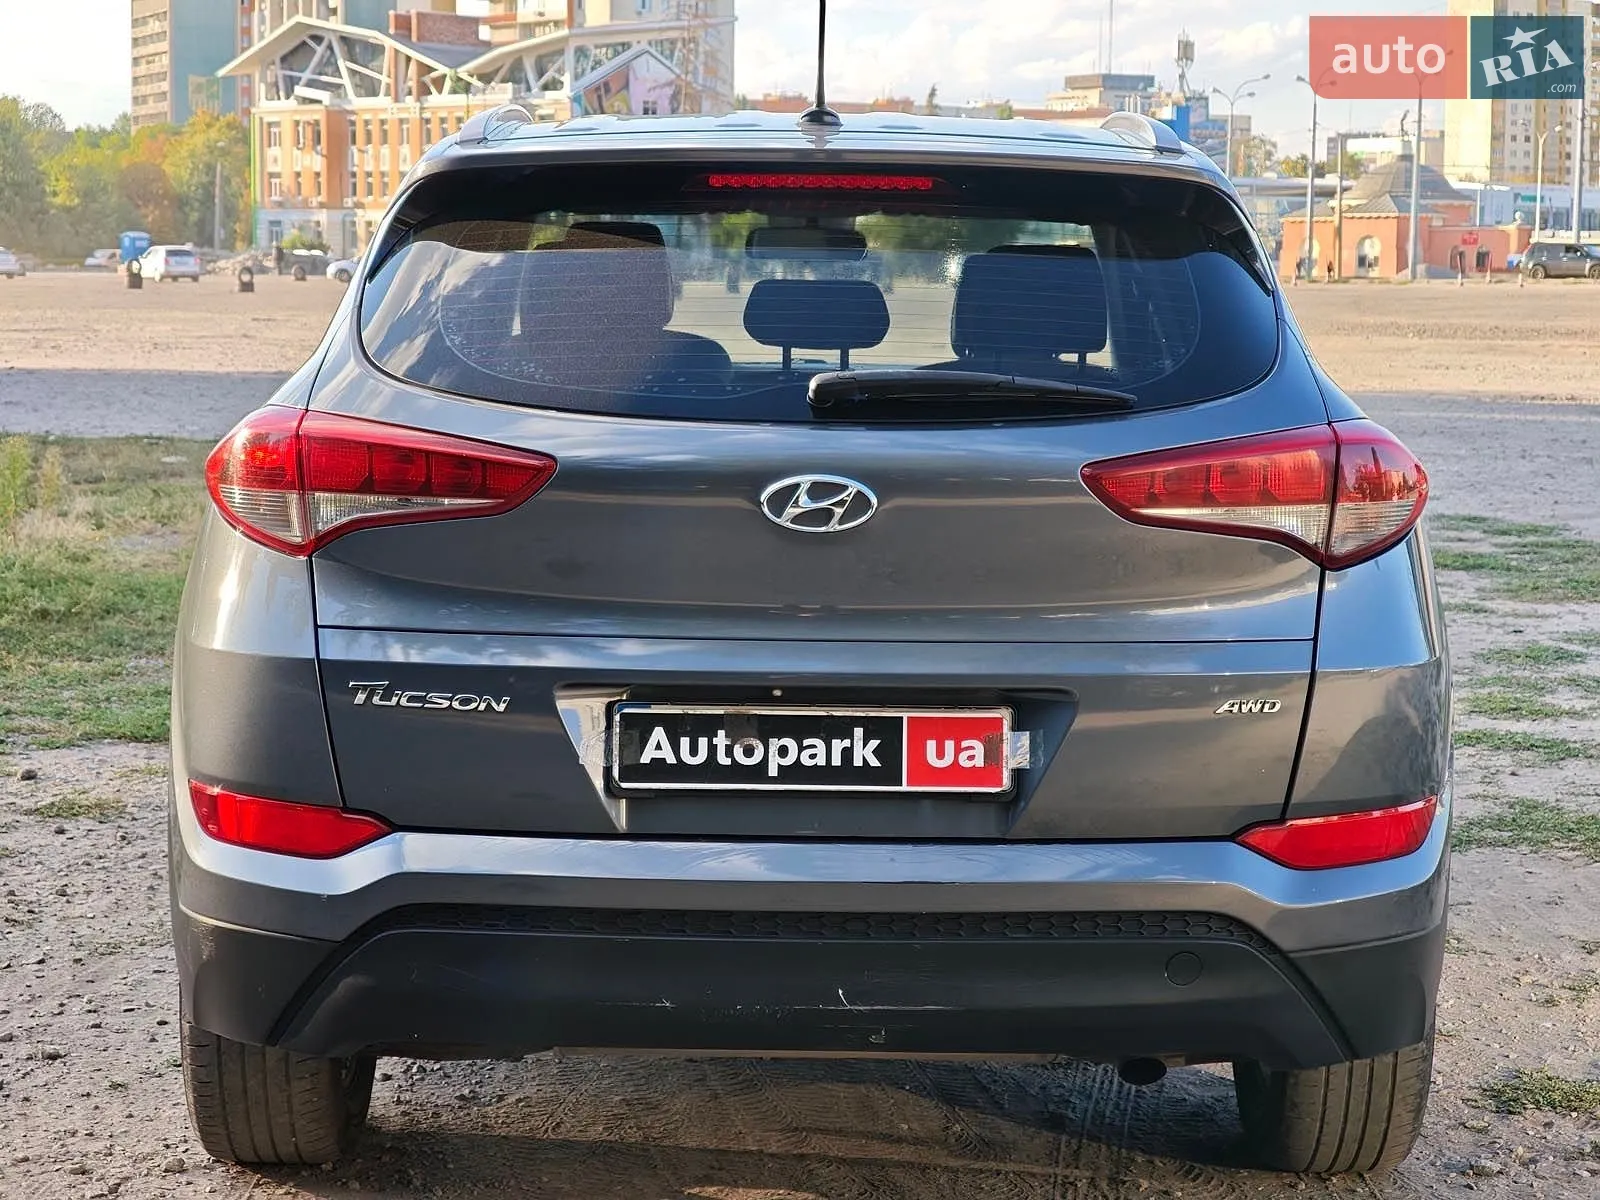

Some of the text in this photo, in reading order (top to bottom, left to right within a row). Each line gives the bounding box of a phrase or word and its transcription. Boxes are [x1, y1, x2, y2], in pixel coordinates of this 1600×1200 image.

[348, 680, 510, 712] TUCSON
[1214, 699, 1281, 714] AWD
[639, 726, 985, 777] Autopark ua
